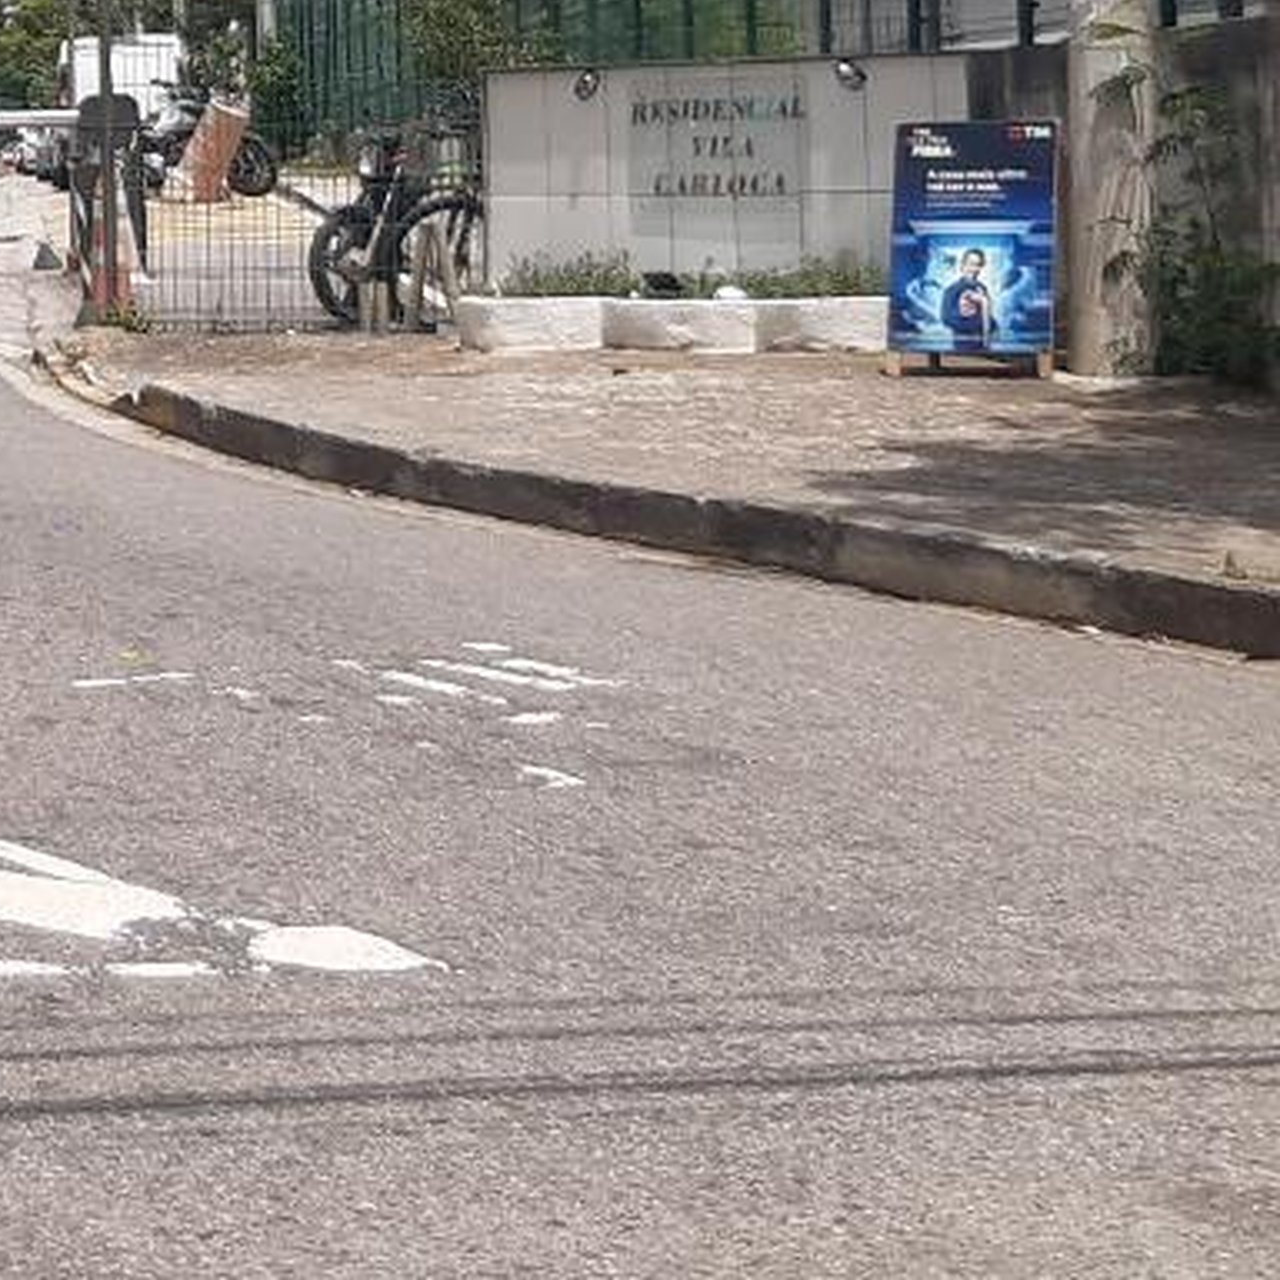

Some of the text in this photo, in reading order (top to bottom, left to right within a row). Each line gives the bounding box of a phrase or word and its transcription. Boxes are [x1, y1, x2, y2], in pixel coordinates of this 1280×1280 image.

[631, 96, 806, 125] RESIDENCIAL
[692, 136, 754, 158] VILA
[653, 173, 786, 197] CARIOCA
